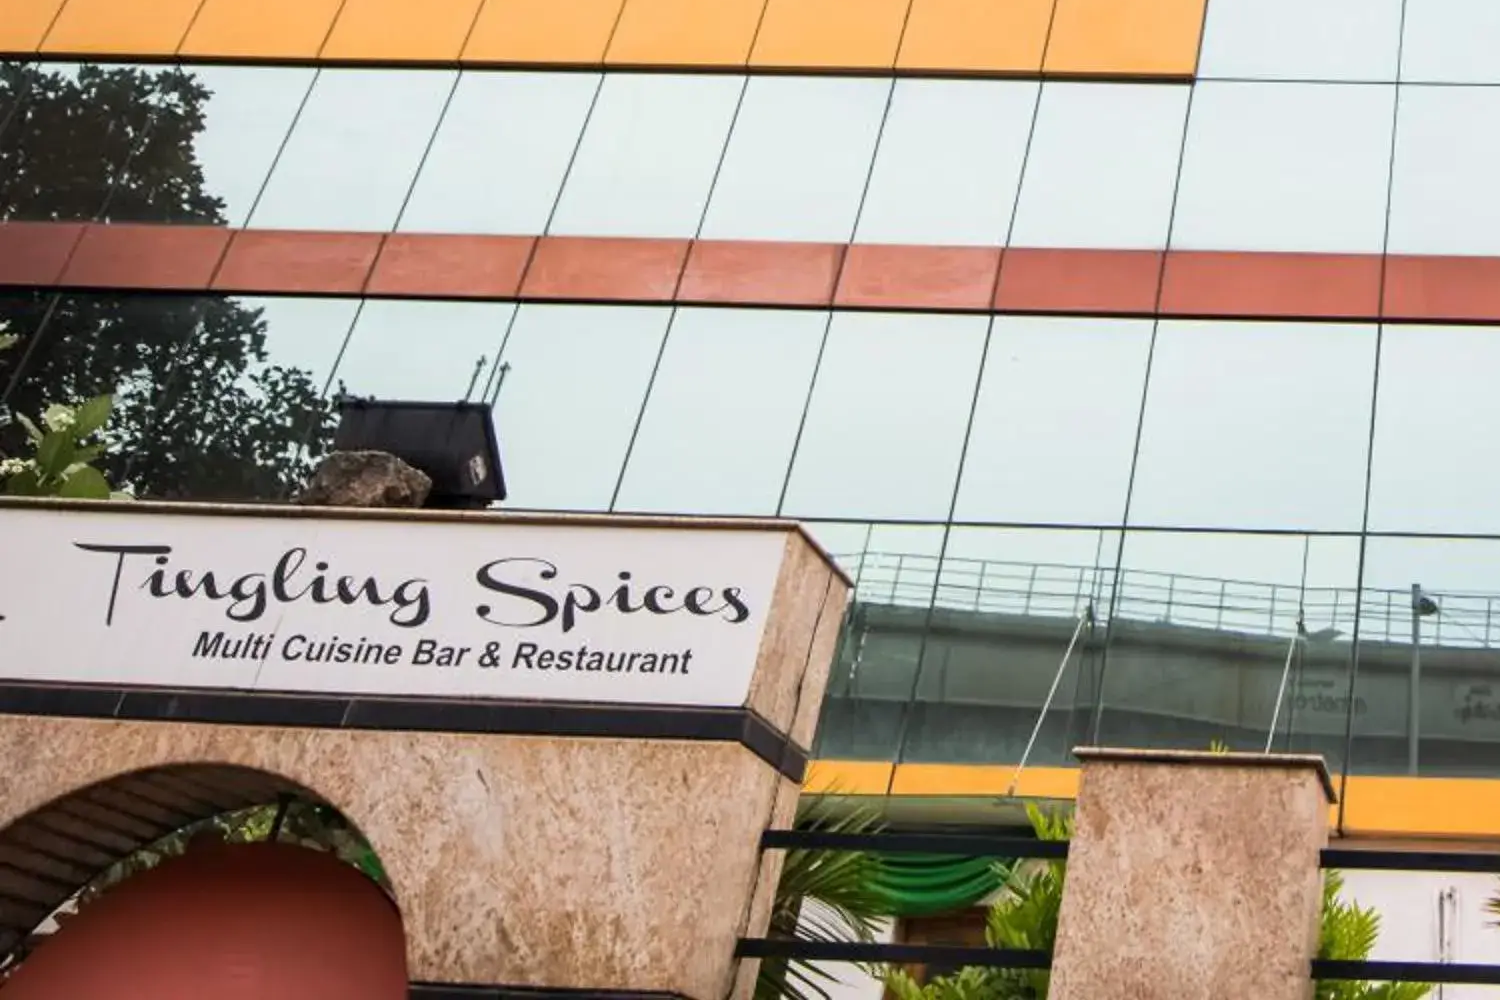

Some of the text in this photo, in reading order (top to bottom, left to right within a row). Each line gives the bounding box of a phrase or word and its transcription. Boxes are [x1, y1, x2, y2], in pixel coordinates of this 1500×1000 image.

[73, 541, 750, 633] Tingling Spices
[192, 631, 693, 675] Multi Cuisine Bar & Restaurant
